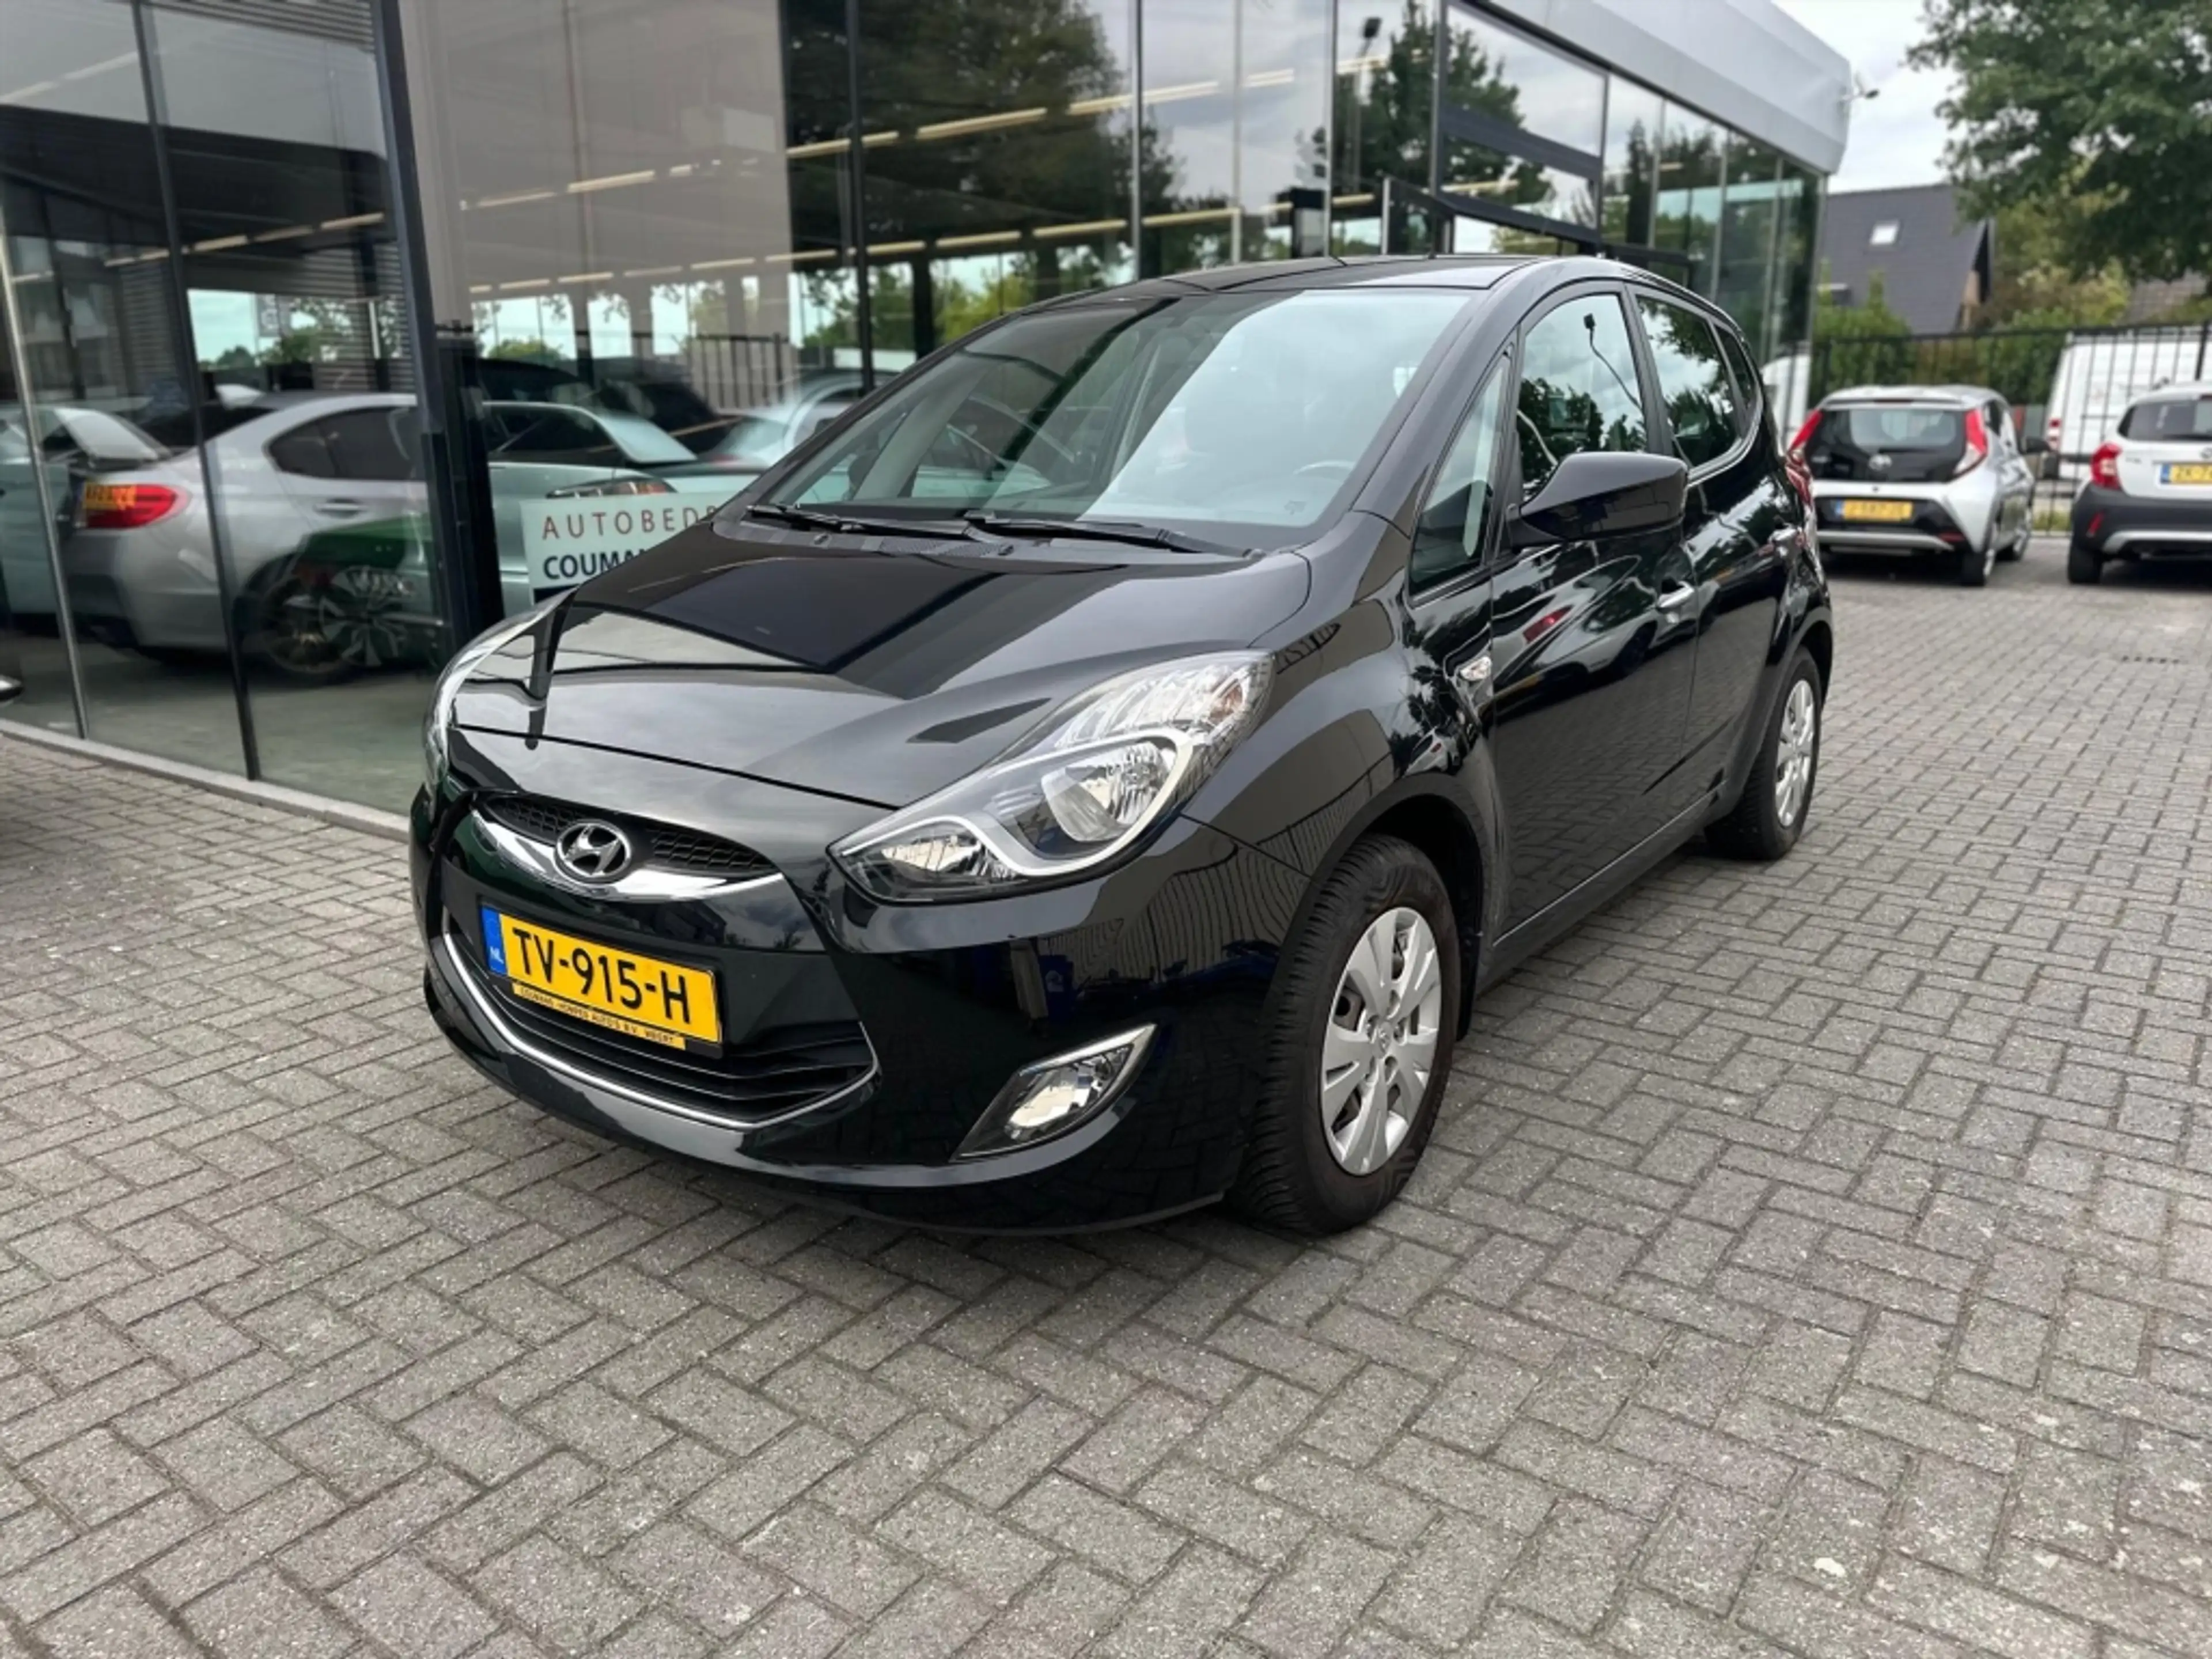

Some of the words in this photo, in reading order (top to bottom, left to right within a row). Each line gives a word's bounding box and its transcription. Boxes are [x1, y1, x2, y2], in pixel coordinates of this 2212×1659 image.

[544, 549, 644, 579] COUM
[490, 946, 505, 964] NL
[512, 927, 690, 1024] TV-915-H
